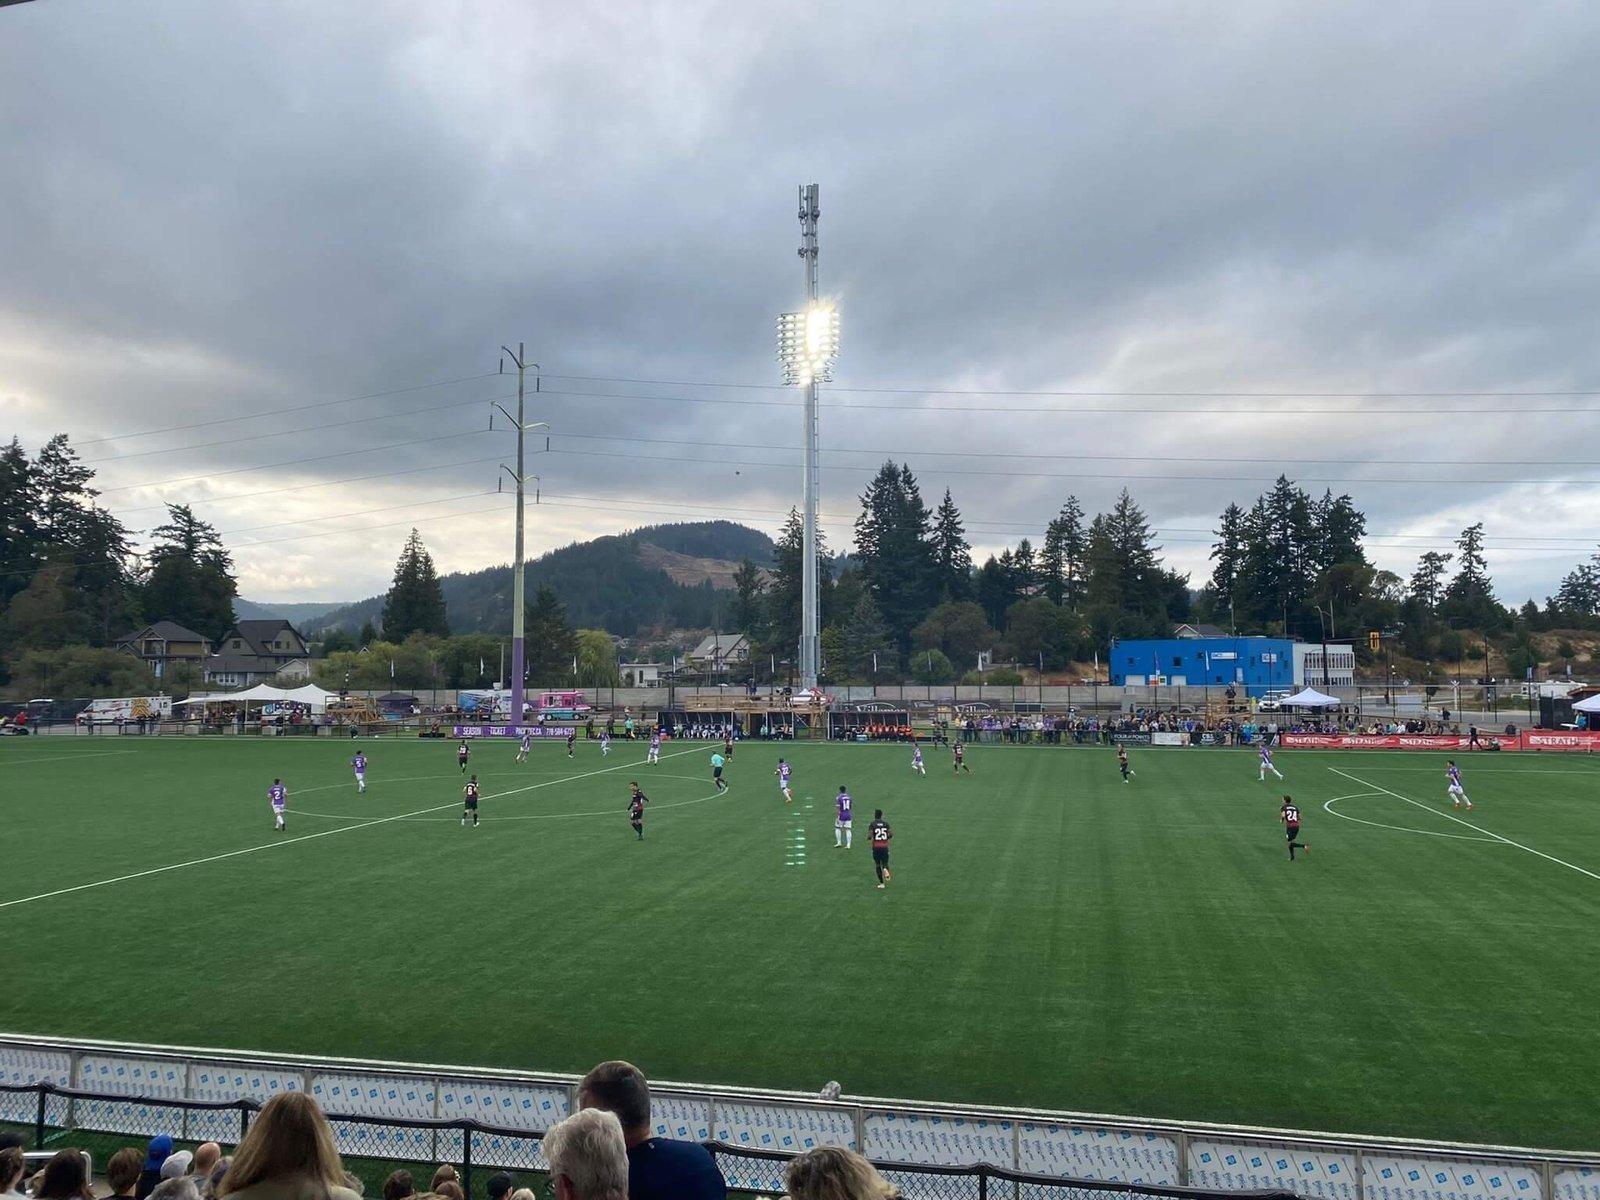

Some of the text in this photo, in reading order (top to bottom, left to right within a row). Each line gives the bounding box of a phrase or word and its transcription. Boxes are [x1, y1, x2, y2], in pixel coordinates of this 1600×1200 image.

[490, 727, 505, 735] TICKET
[1539, 737, 1577, 745] STRATH
[274, 791, 281, 800] 2
[1286, 810, 1298, 822] 24
[874, 828, 888, 841] 25
